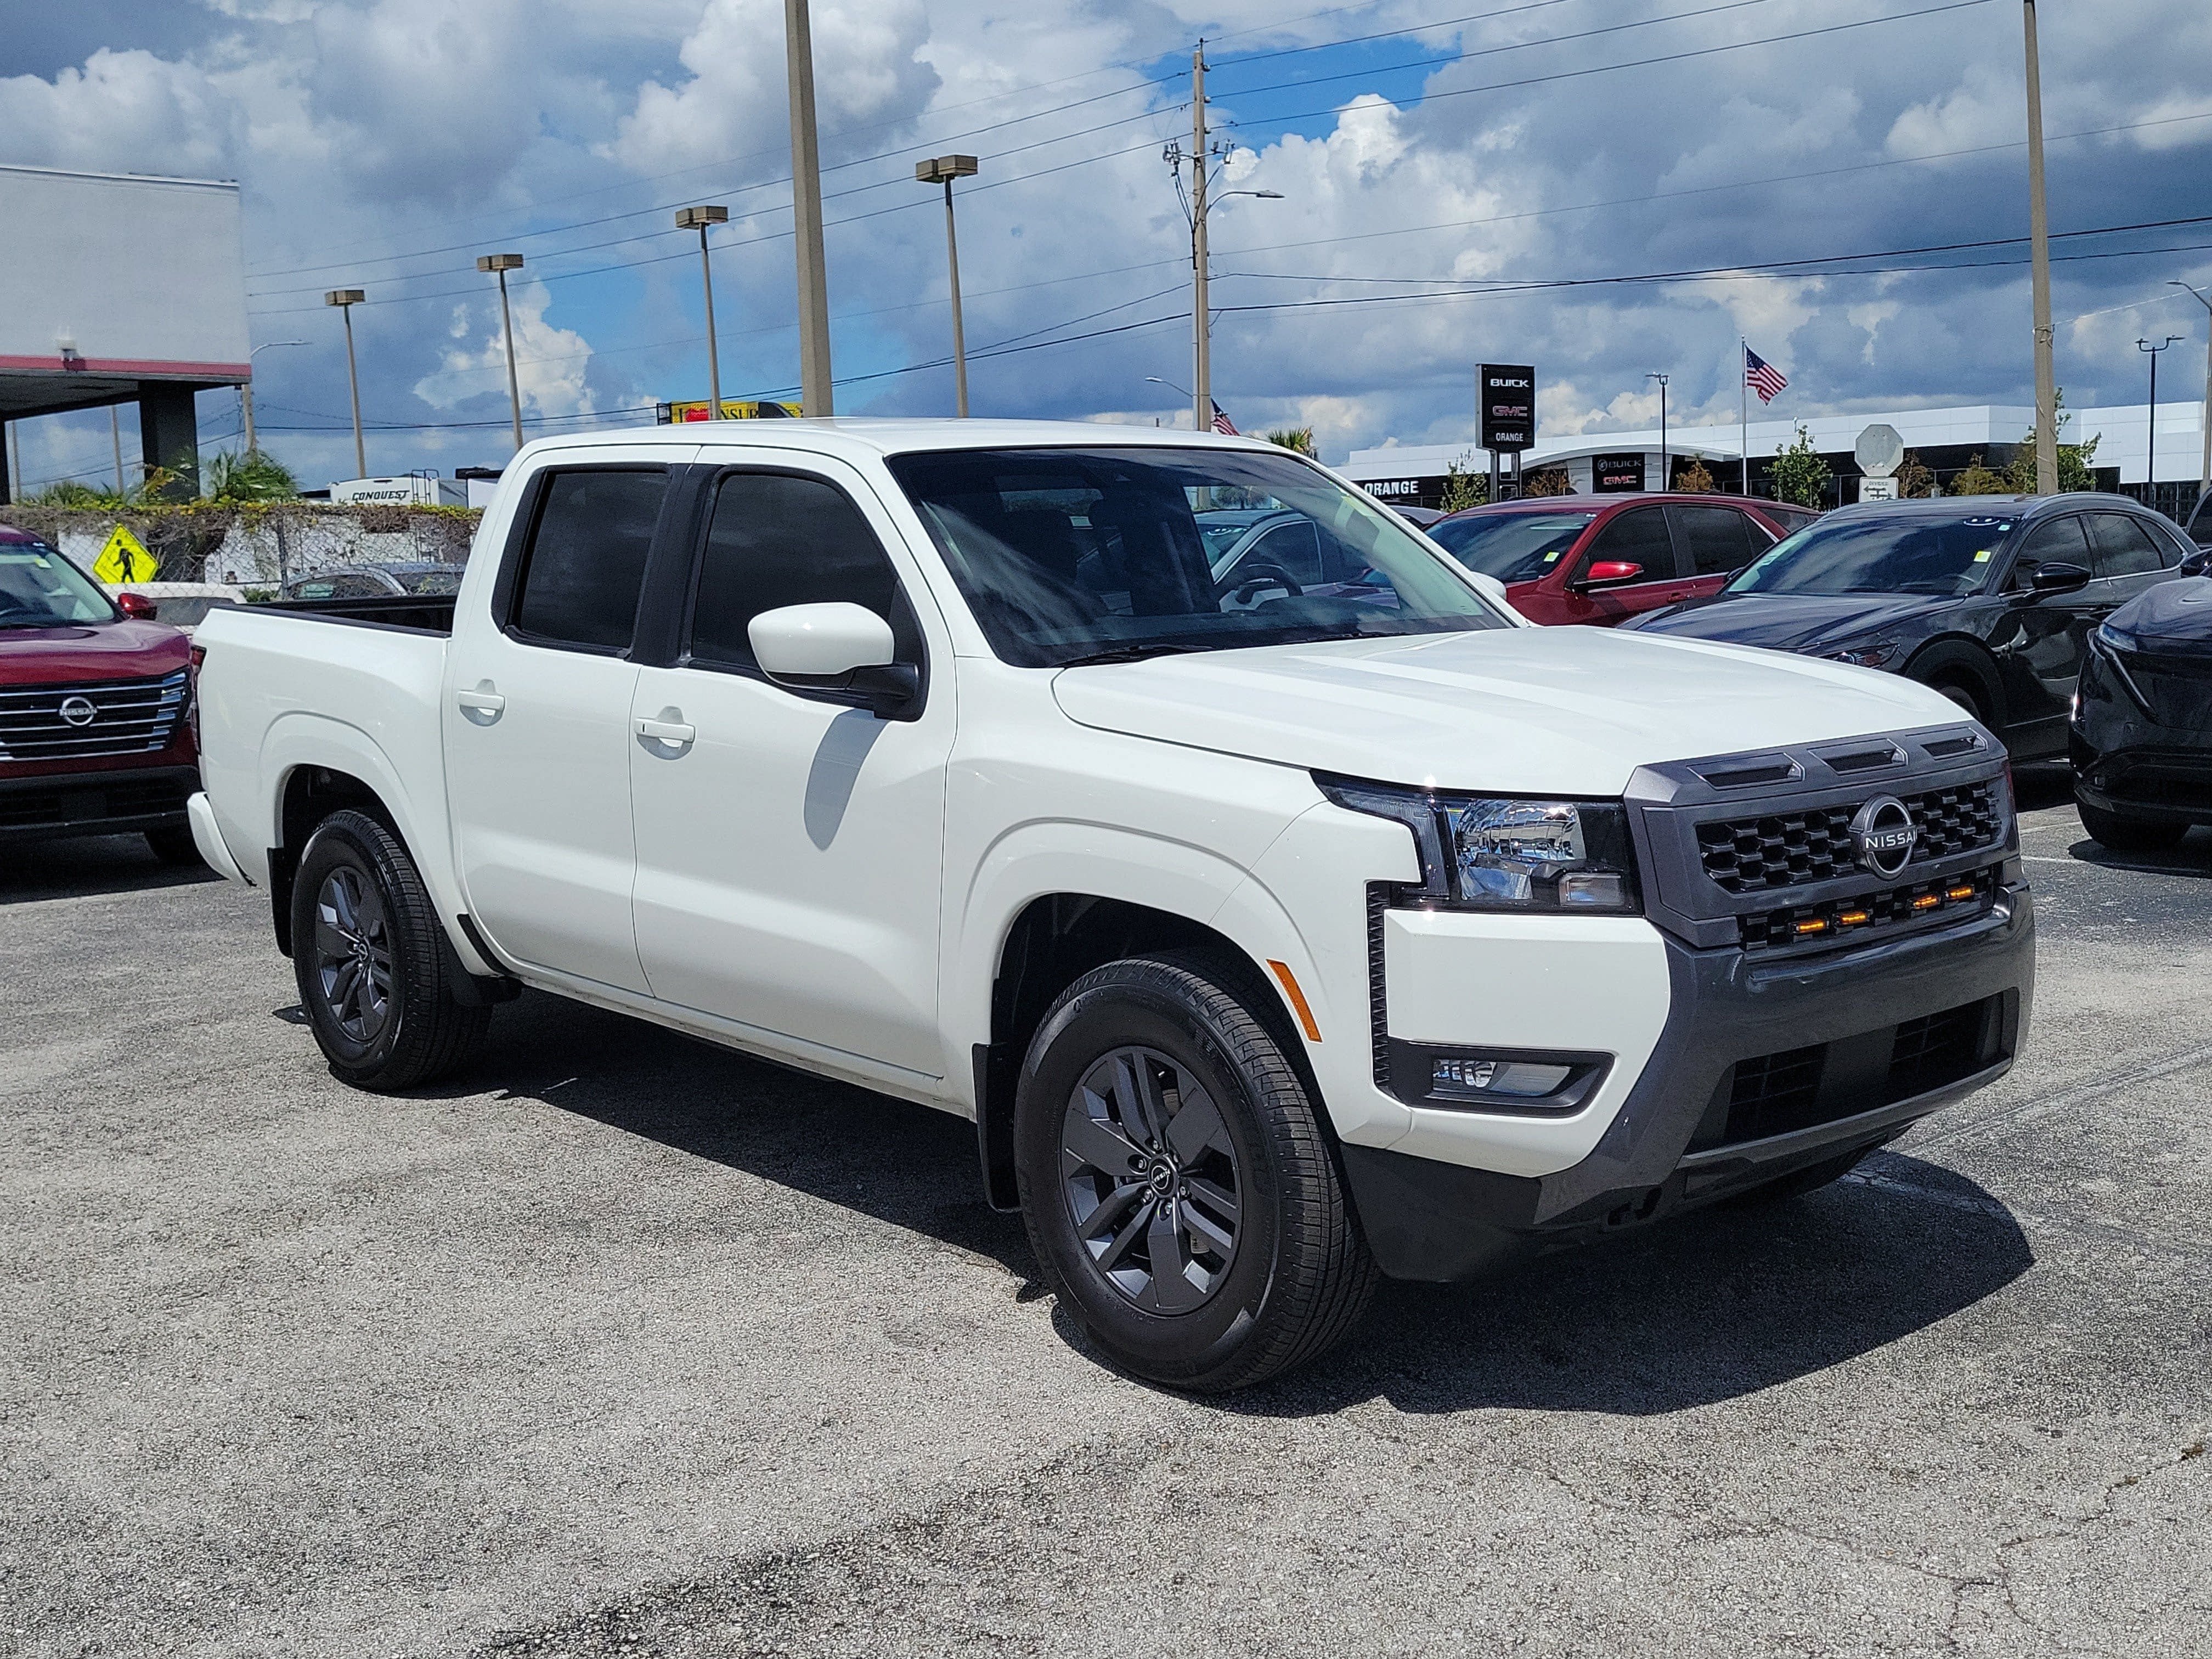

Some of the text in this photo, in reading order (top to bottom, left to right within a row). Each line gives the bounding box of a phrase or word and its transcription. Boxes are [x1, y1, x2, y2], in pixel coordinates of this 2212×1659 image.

[1490, 379, 1530, 387] BUICK
[1493, 405, 1528, 416] GMC
[1496, 432, 1523, 442] ORANGE
[1609, 459, 1641, 468] BUICK
[1603, 475, 1637, 485] GMC
[1364, 481, 1419, 495] ORANGE
[352, 490, 410, 501] CONQUEST
